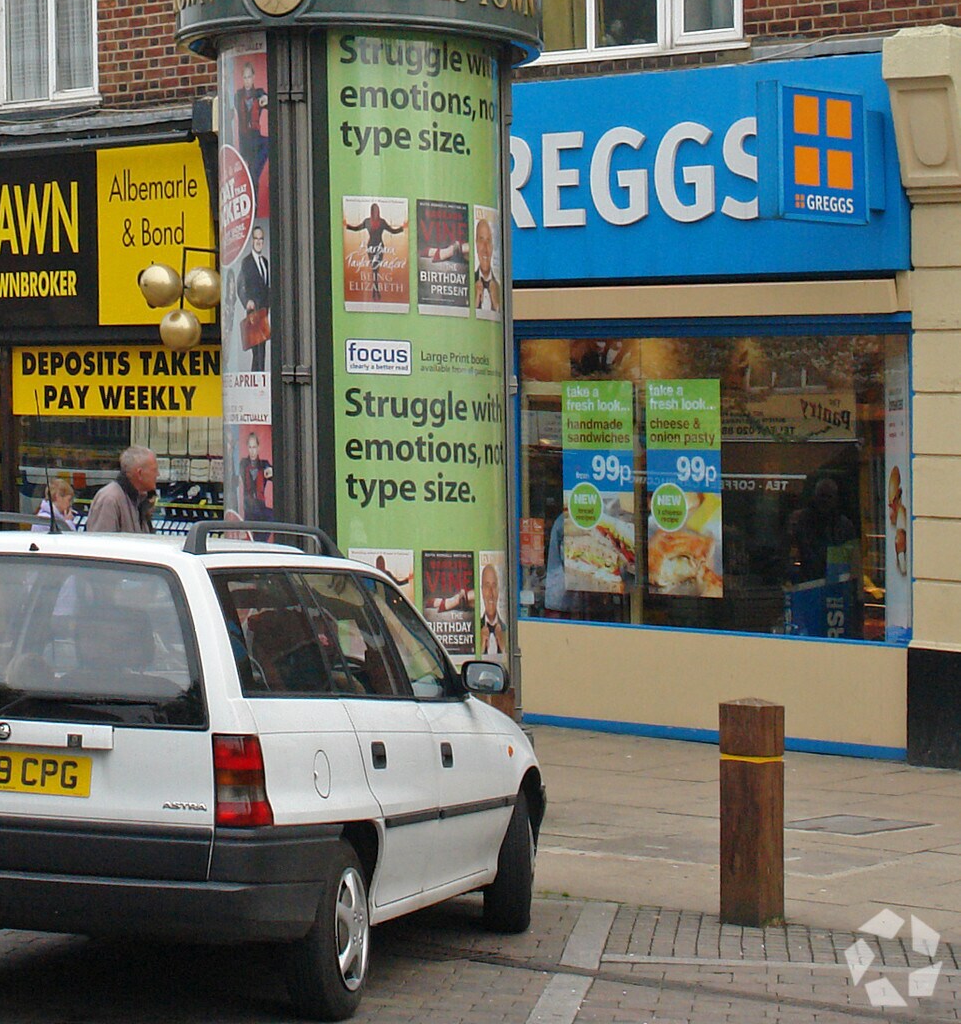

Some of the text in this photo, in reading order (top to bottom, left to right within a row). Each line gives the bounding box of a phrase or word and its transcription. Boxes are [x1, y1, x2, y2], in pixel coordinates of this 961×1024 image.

[339, 34, 462, 77] Struggle
[340, 81, 496, 122] emotions, no
[340, 120, 471, 156] type size.
[511, 116, 758, 229] REGGS
[109, 165, 198, 203] Albemarle
[806, 194, 854, 214] GREGGS
[122, 211, 185, 247] & Bond
[420, 219, 469, 243] VINE
[349, 280, 404, 293] ELIZABETH
[360, 271, 393, 282] BEING
[420, 270, 466, 285] BIRTHDAY
[430, 284, 468, 297] PRESENT
[348, 342, 408, 364] focus
[420, 350, 448, 365] Large
[450, 352, 470, 364] Print
[22, 351, 220, 376] DEPOSITS TAKEN
[234, 374, 258, 387] APRIL
[649, 384, 684, 396] take a
[44, 385, 196, 411] PAY WEEKLY
[566, 385, 599, 398] take a
[345, 387, 503, 428] Struggle with
[566, 399, 595, 412] fresh
[649, 398, 679, 411] fresh
[567, 418, 623, 430] handmade
[650, 417, 701, 430] cheese &
[567, 431, 631, 444] sandwiches
[650, 431, 716, 446] onion pasty
[345, 432, 481, 469] emotions,
[591, 454, 632, 486] 99p
[676, 455, 717, 486] 99p
[345, 472, 476, 509] type size.
[574, 494, 598, 505] NEW
[657, 494, 682, 506] NEW
[425, 570, 473, 593] VINE
[21, 758, 78, 790] CPG
[161, 800, 208, 812] ASTRA
